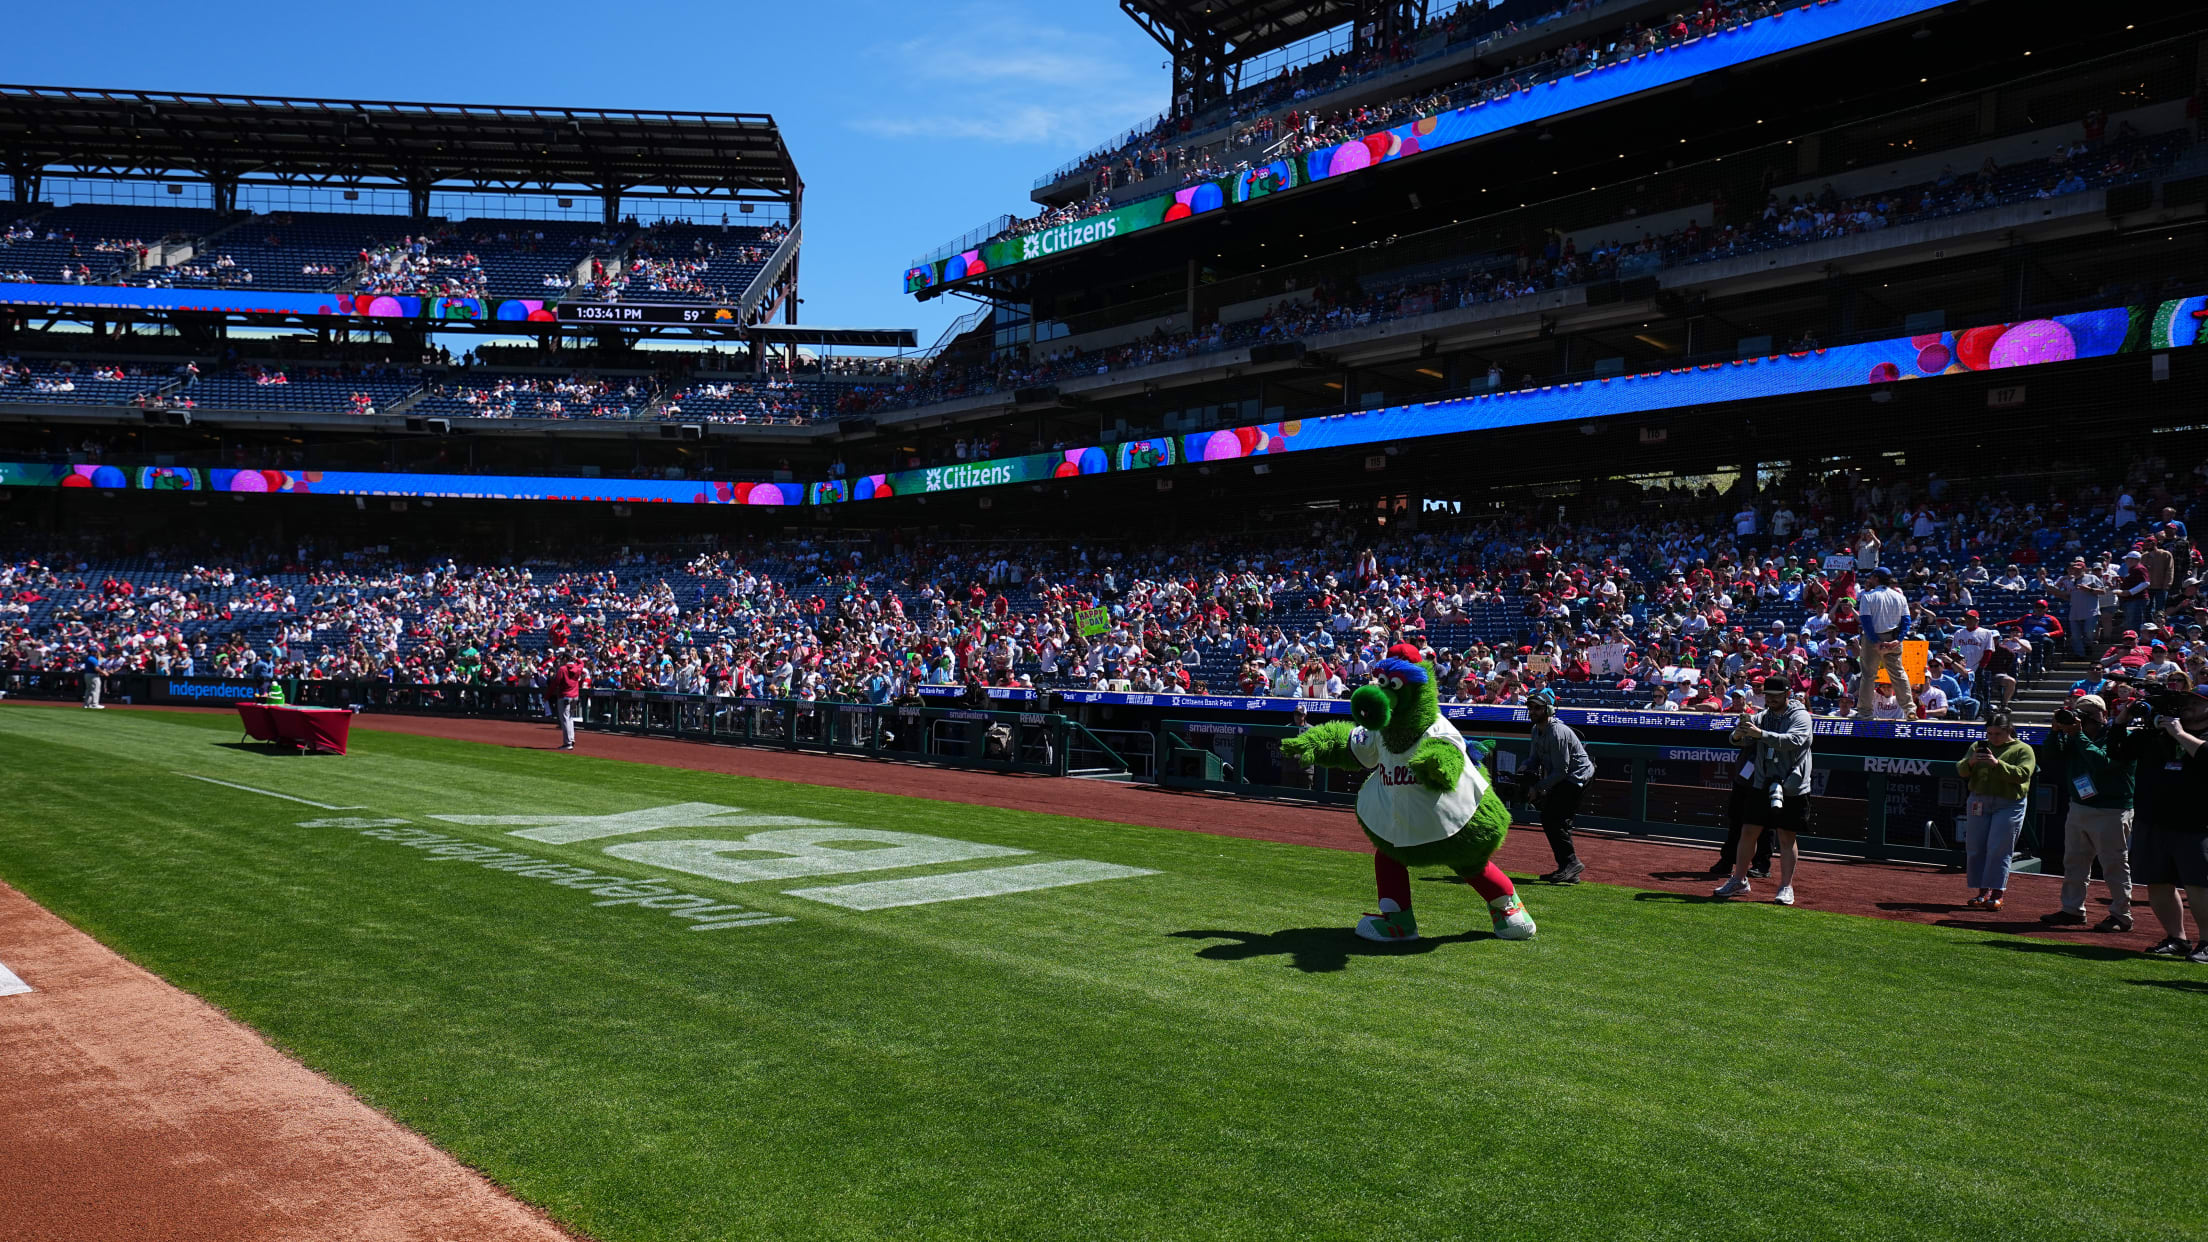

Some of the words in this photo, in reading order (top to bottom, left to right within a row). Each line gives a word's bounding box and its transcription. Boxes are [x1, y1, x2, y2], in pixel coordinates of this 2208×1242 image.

[1042, 217, 1117, 254] Citizens
[577, 307, 620, 319] 1:03:41
[624, 308, 642, 319] PM
[943, 465, 1011, 489] Citizens
[168, 681, 254, 700] Independence
[1601, 714, 1638, 724] Citizens
[1640, 716, 1663, 726] Bank
[1665, 717, 1686, 727] Park
[1189, 723, 1237, 735] smartwater
[1915, 726, 1965, 738] Citizens
[1669, 749, 1738, 763] smartwat
